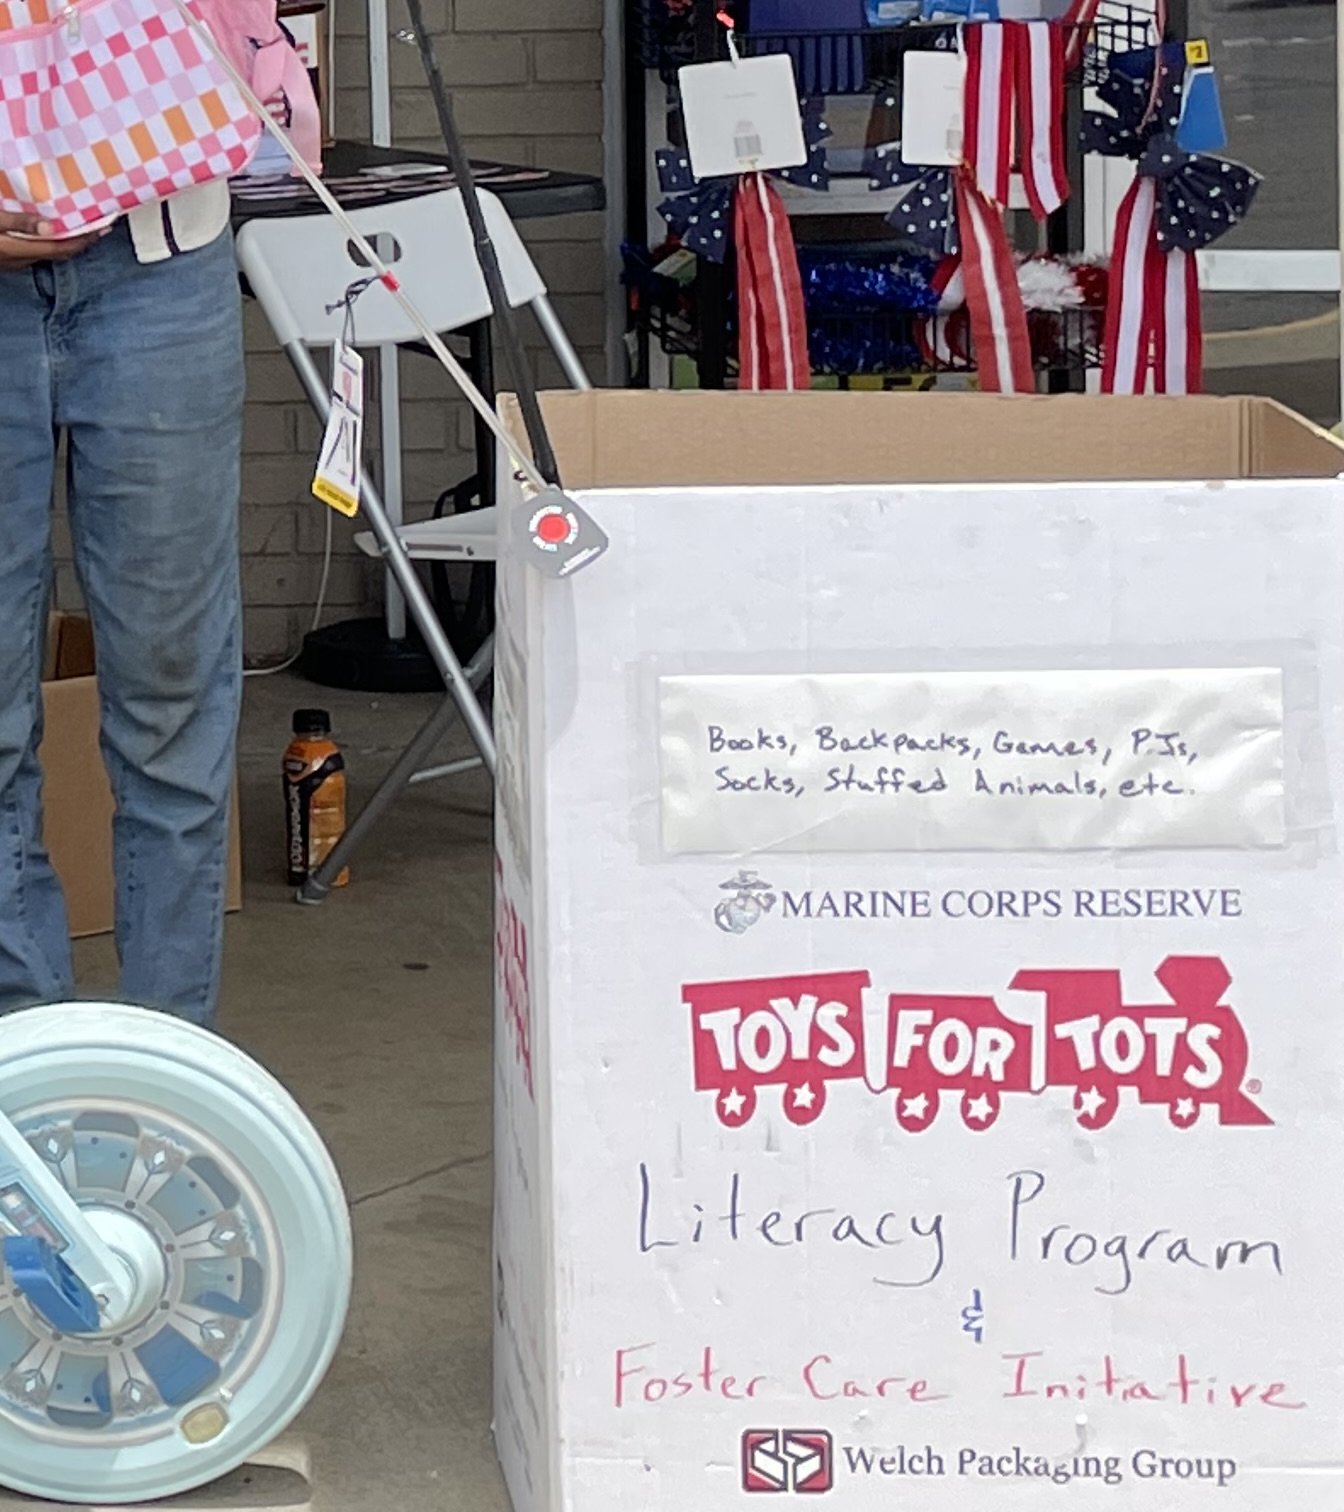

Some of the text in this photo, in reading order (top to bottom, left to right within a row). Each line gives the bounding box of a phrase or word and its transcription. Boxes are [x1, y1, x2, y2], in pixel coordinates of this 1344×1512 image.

[707, 725, 798, 756] Books,
[815, 725, 982, 761] Backpacks,
[992, 730, 1113, 766] Games,
[714, 766, 805, 798] Socks,
[823, 764, 949, 794] Stuffed
[973, 768, 1108, 799] Animals,
[782, 888, 1243, 918] MARINE CORPS RESERVE
[699, 990, 1223, 1086] TOYS FOR TOTS
[638, 1162, 1283, 1295] Literacy Program
[612, 1344, 1308, 1411] Foster Care Initiative
[841, 1445, 1238, 1487] Welch Packaging Group
